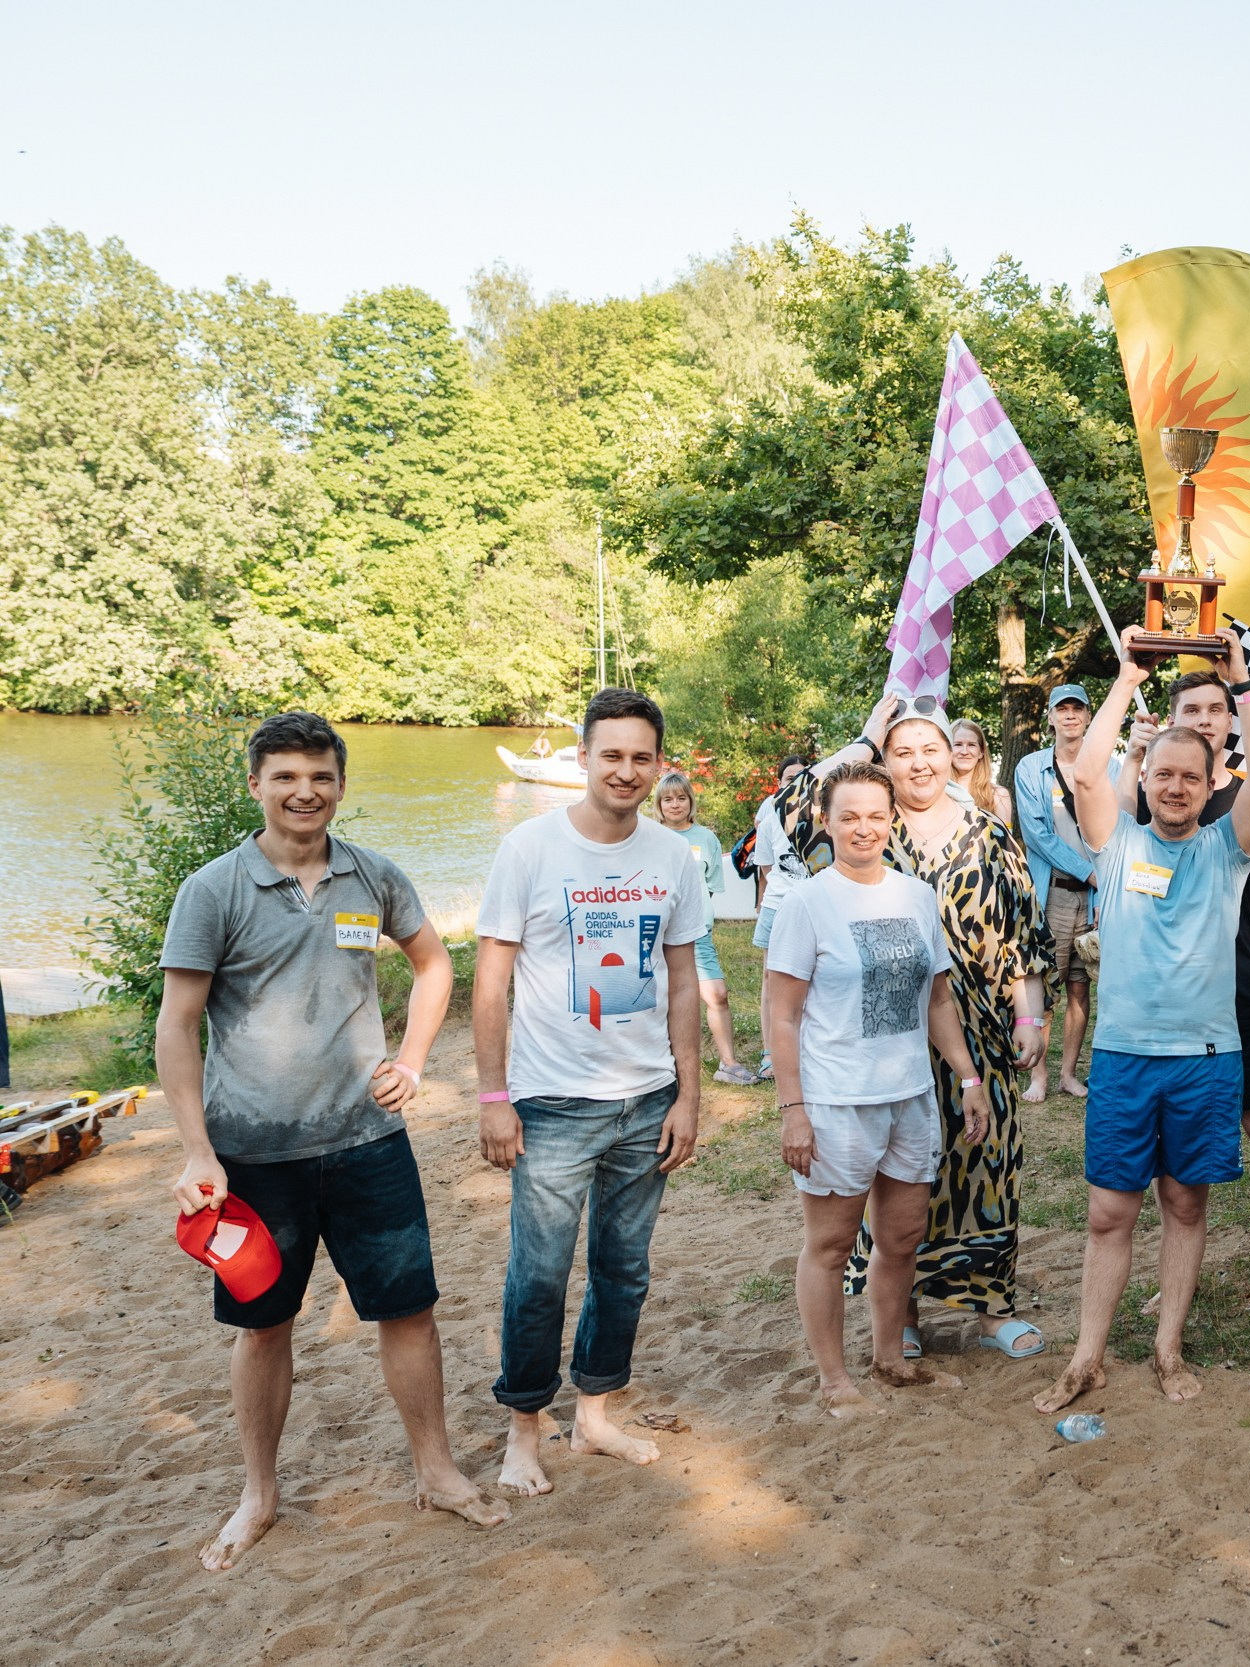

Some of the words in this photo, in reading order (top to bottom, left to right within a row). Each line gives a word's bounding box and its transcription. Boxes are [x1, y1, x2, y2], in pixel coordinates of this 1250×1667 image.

[572, 886, 642, 903] adidas
[585, 911, 618, 920] ADIDAS
[586, 919, 635, 929] ORIGINALS
[586, 930, 613, 938] SINCE
[873, 944, 915, 961] LOVELY
[882, 977, 910, 991] WILD
